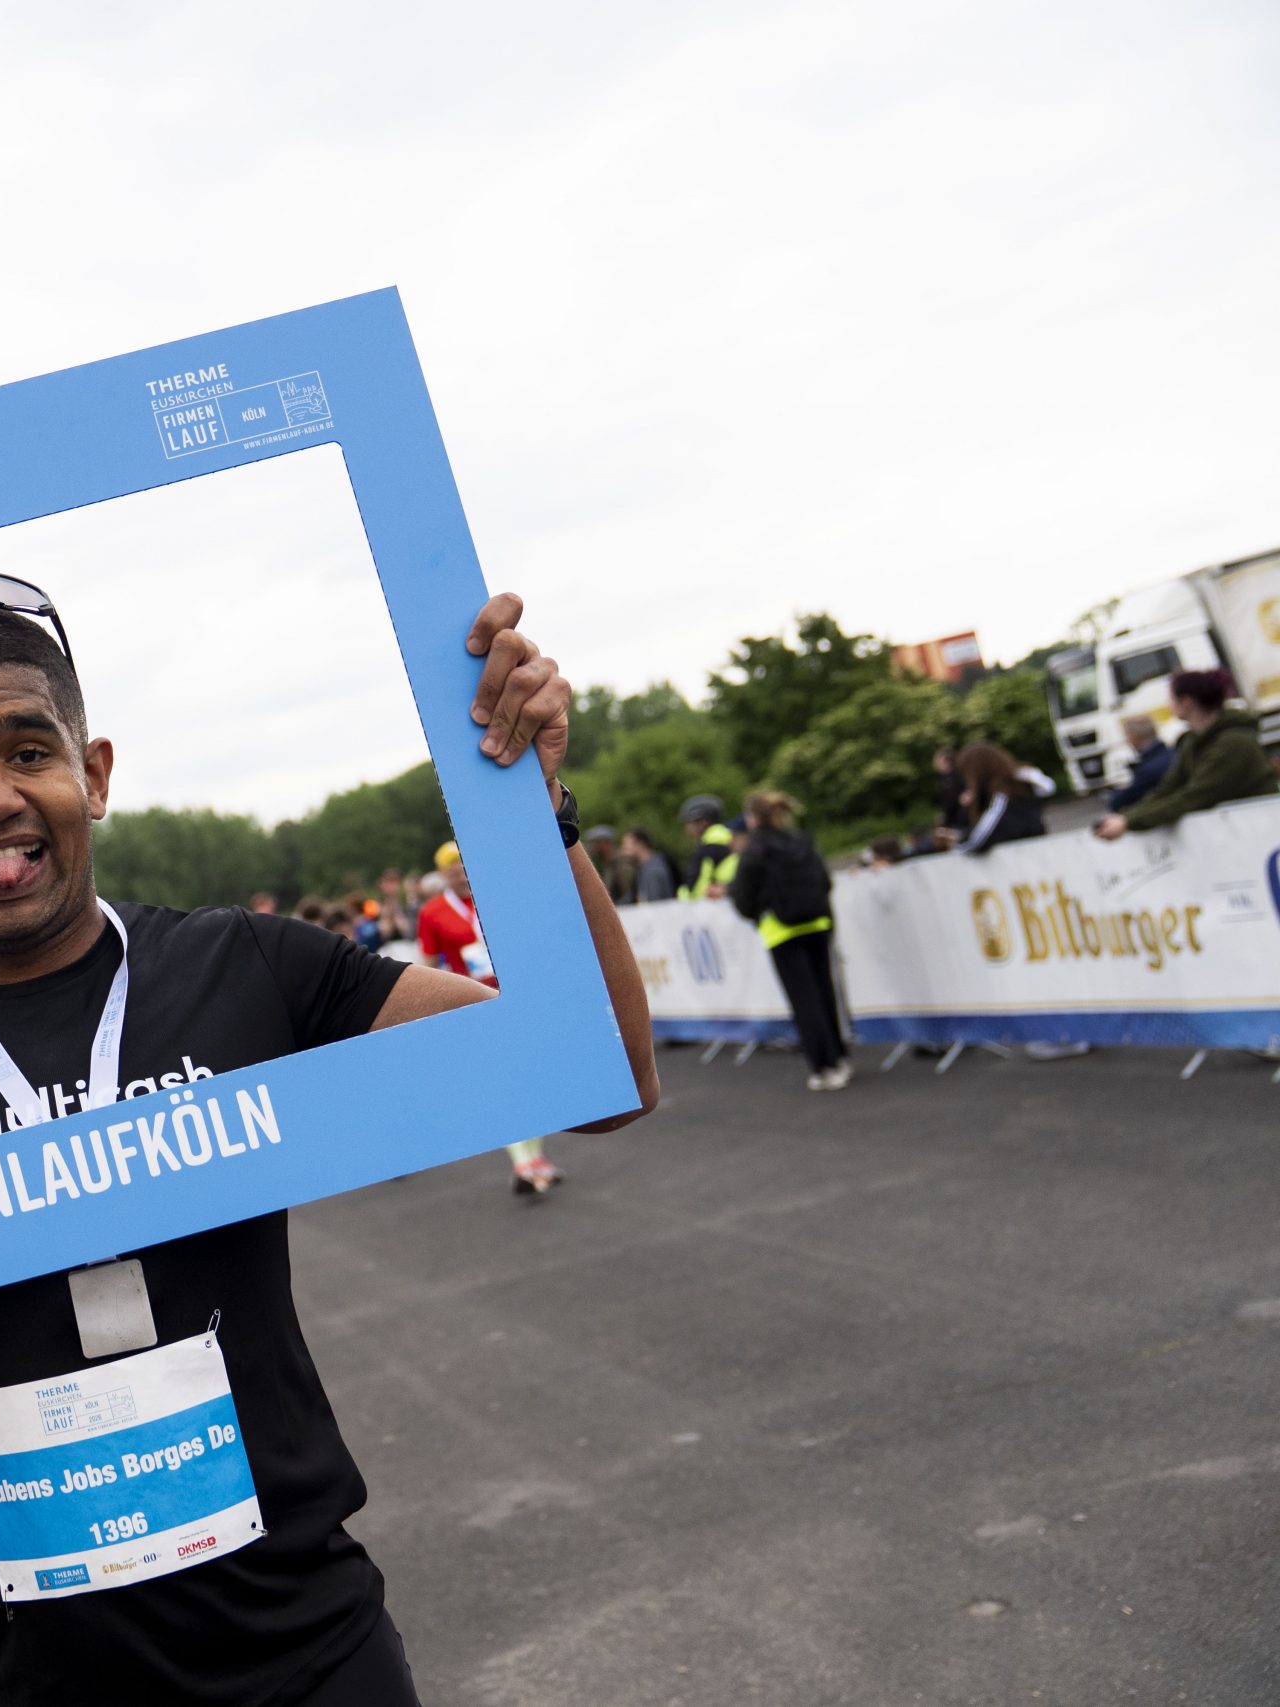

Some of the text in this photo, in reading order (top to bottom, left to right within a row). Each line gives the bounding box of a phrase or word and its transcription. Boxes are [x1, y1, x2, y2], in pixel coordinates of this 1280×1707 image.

[145, 363, 230, 396] THERME
[151, 381, 234, 411] EUSKIRCHEN
[162, 404, 215, 429] FIRMEN
[241, 406, 266, 422] KÖLN
[167, 420, 219, 451] LAUF
[243, 422, 335, 450] WWW.FIRMENLAUF-KOELN.DE
[1011, 878, 1203, 972] Bitburger
[35, 1382, 80, 1399] THERME
[37, 1392, 82, 1408] EUSKIRCHEN
[43, 1406, 72, 1419] FIRMEN
[46, 1416, 74, 1432] LAUF
[60, 1463, 117, 1494] Jobs
[121, 1436, 205, 1479] Borges
[208, 1423, 236, 1450] De
[89, 1511, 148, 1545] 1396
[177, 1539, 208, 1557] DKMS
[53, 1568, 85, 1580] THERME
